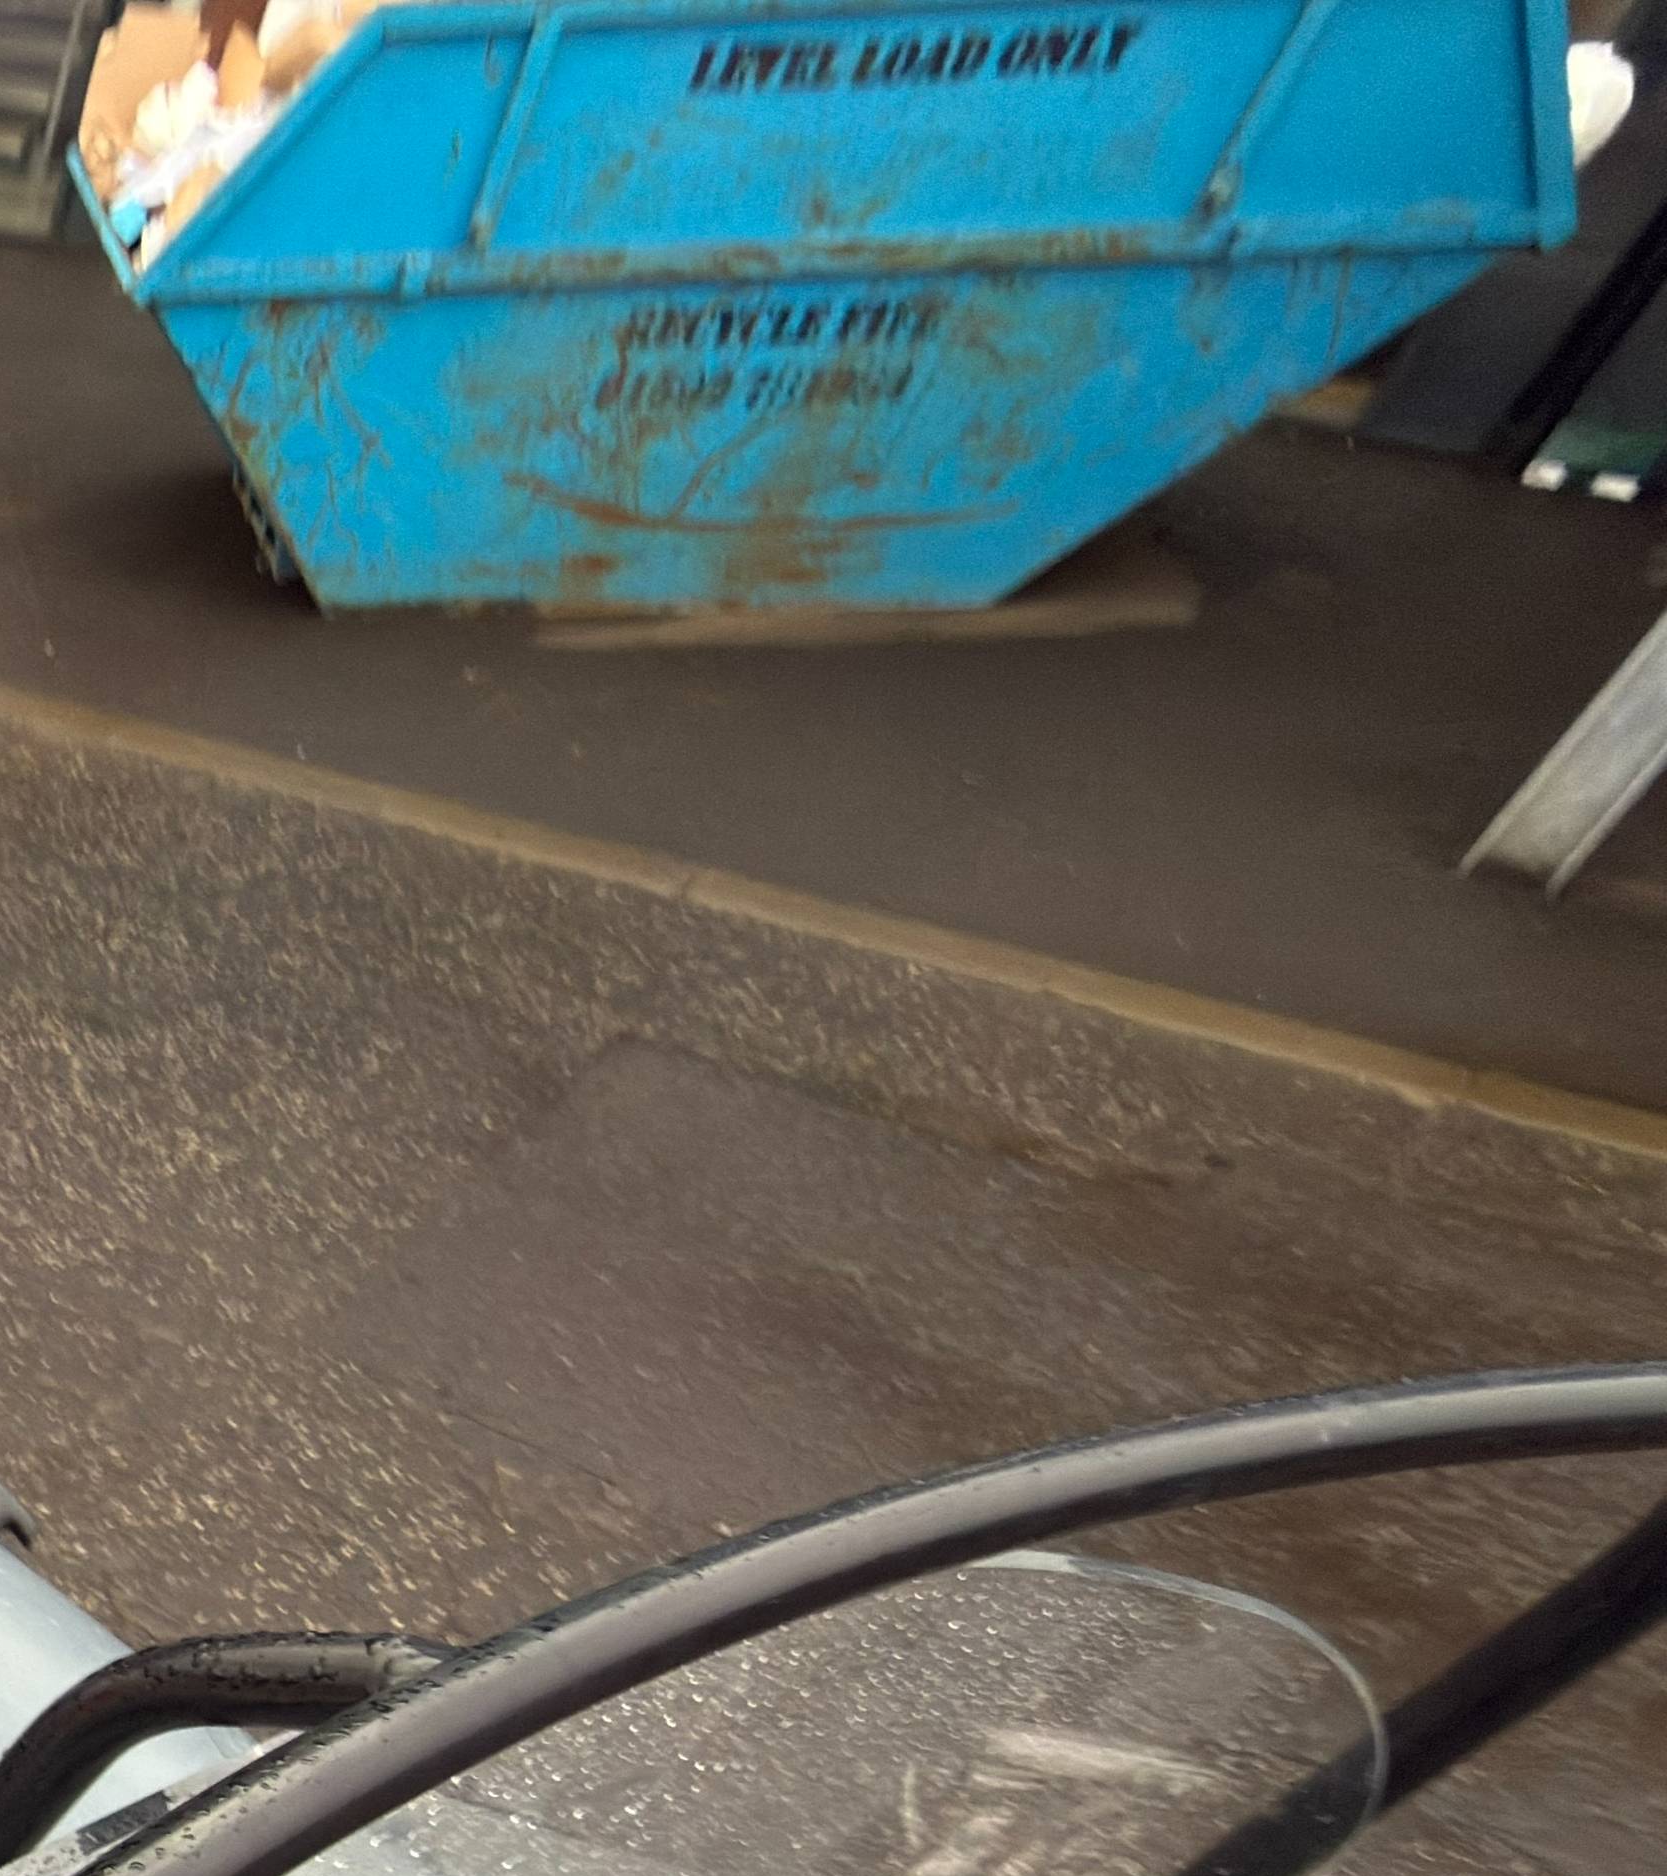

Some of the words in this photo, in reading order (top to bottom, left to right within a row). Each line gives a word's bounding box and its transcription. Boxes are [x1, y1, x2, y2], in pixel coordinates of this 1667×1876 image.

[688, 38, 839, 94] LEVEL
[850, 30, 993, 87] LOAD
[995, 17, 1145, 79] ONLY
